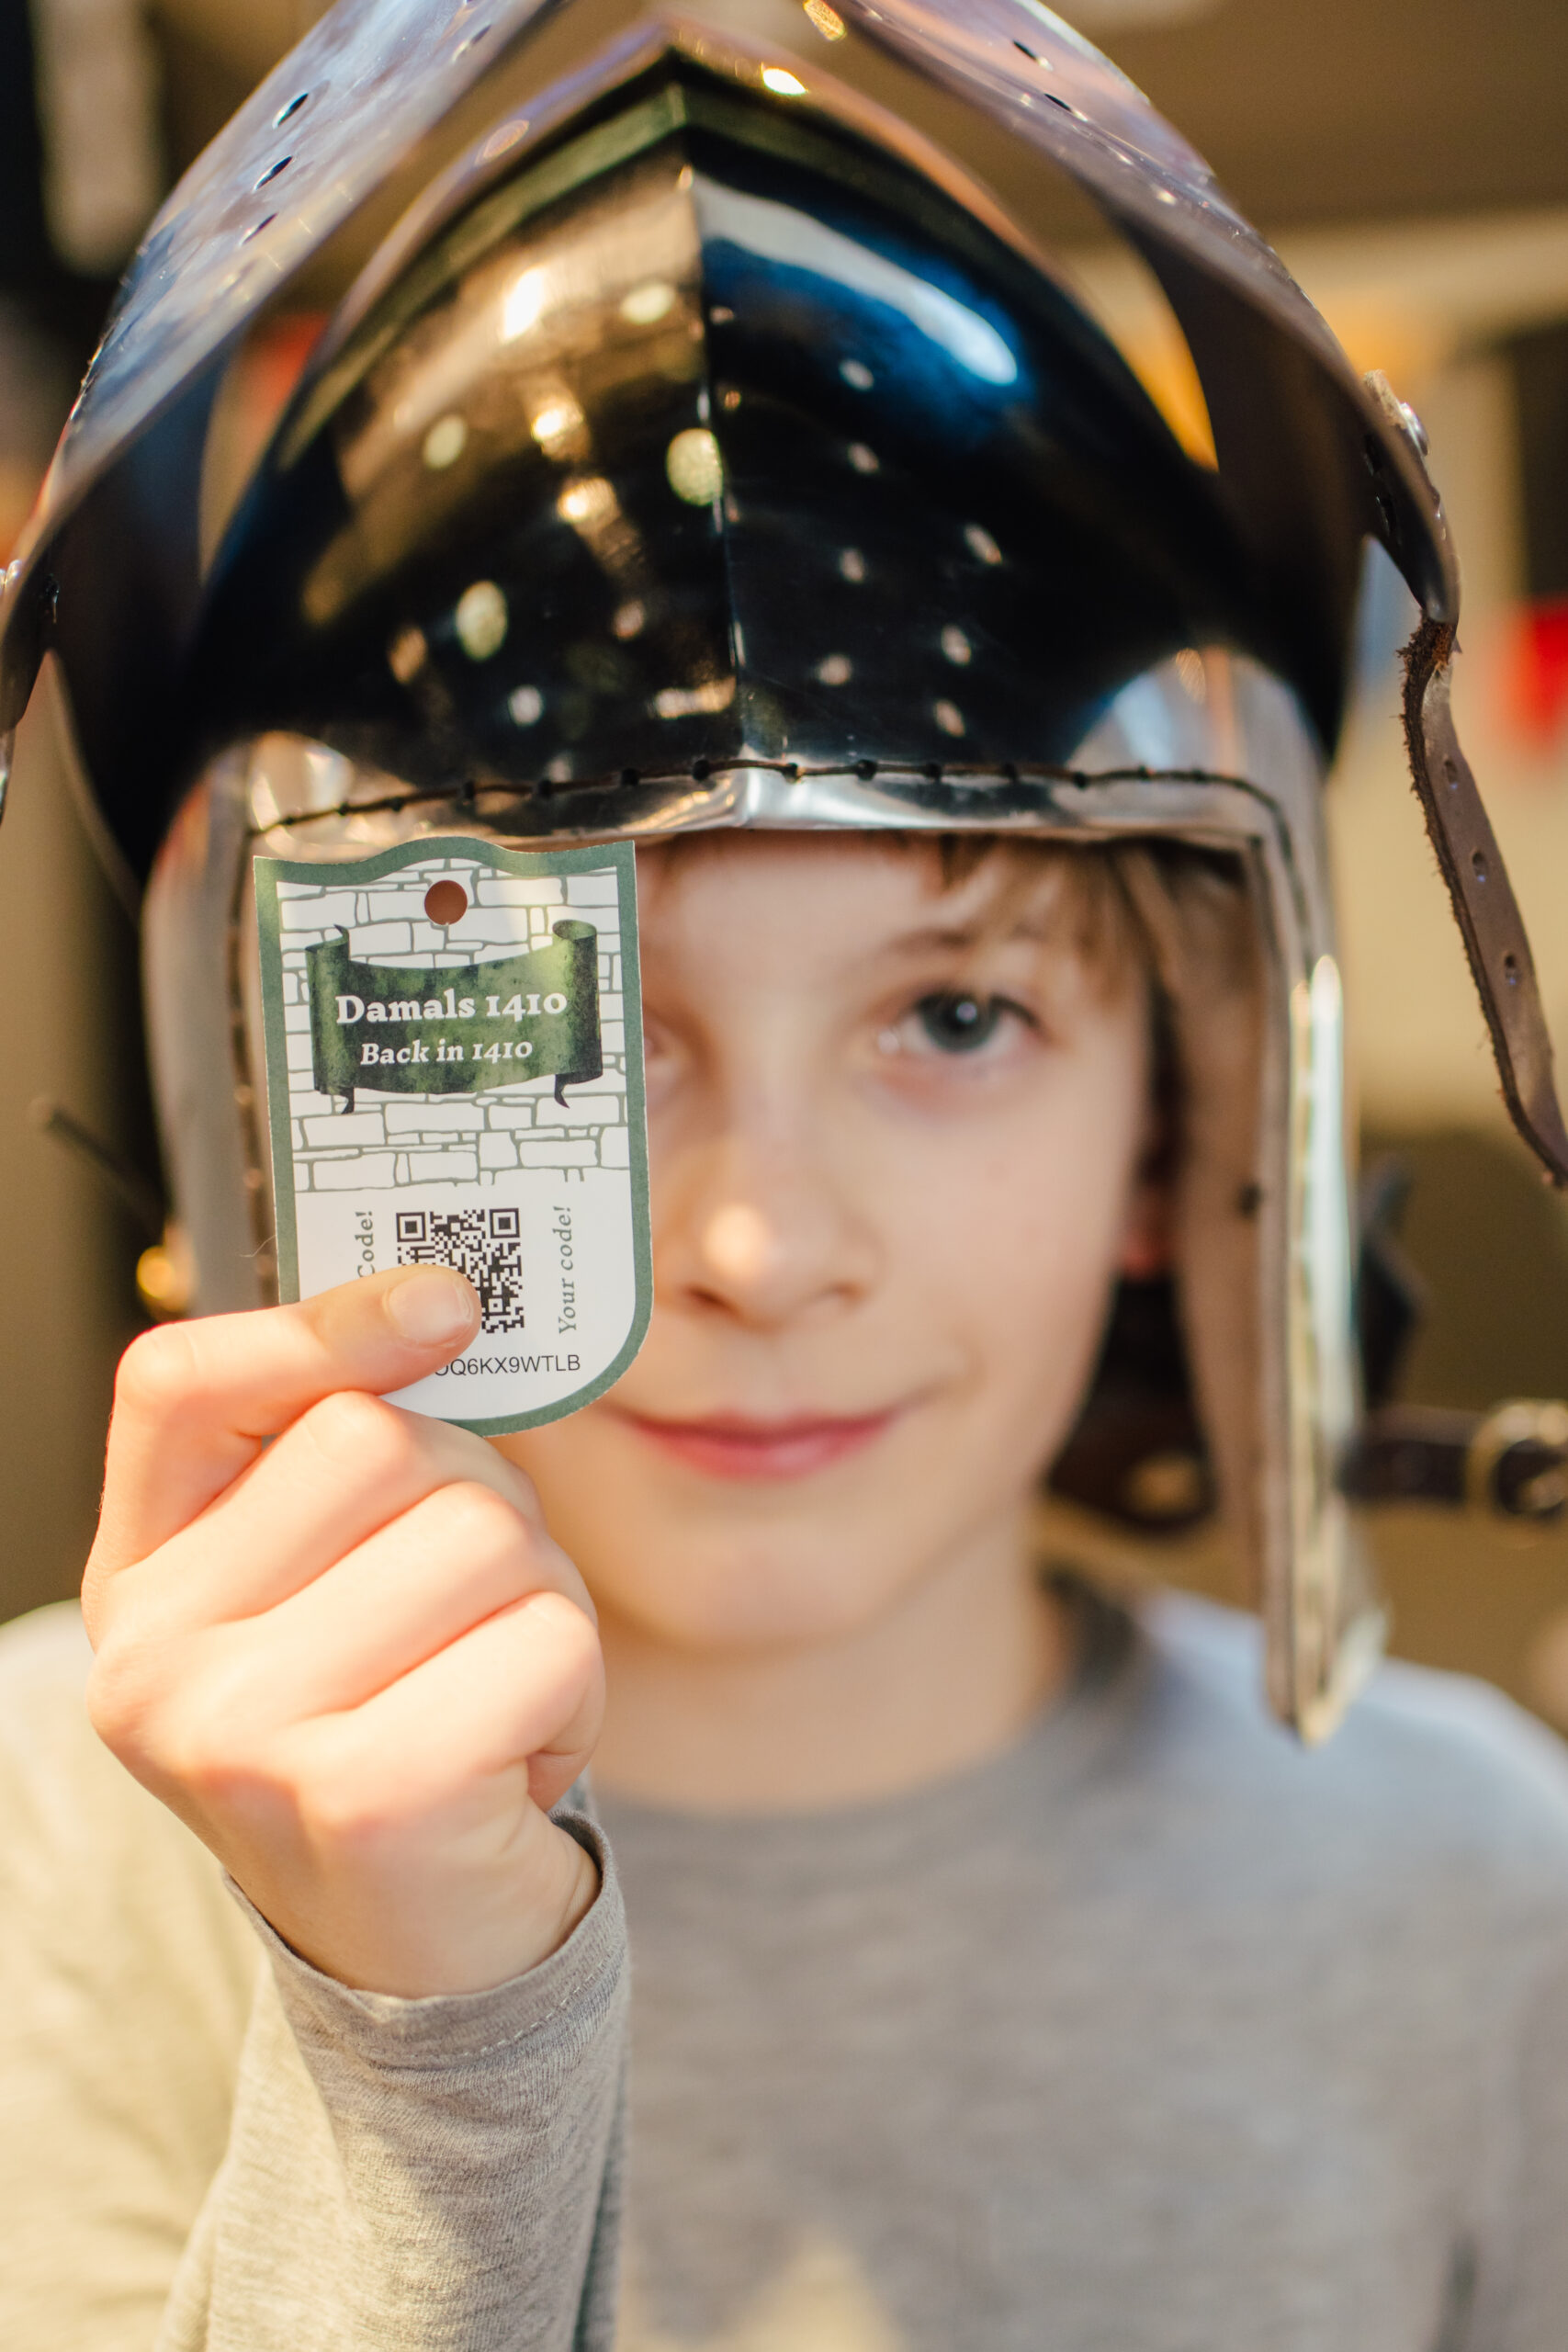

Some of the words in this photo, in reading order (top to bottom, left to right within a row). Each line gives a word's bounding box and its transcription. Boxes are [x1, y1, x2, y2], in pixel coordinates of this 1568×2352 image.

[335, 988, 476, 1023] Damals
[485, 992, 568, 1023] 1410
[359, 1039, 429, 1066] Back
[435, 1038, 464, 1062] in
[472, 1041, 533, 1064] 1410
[355, 1211, 375, 1277] Code!
[552, 1205, 573, 1271] code!
[558, 1277, 577, 1334] Your
